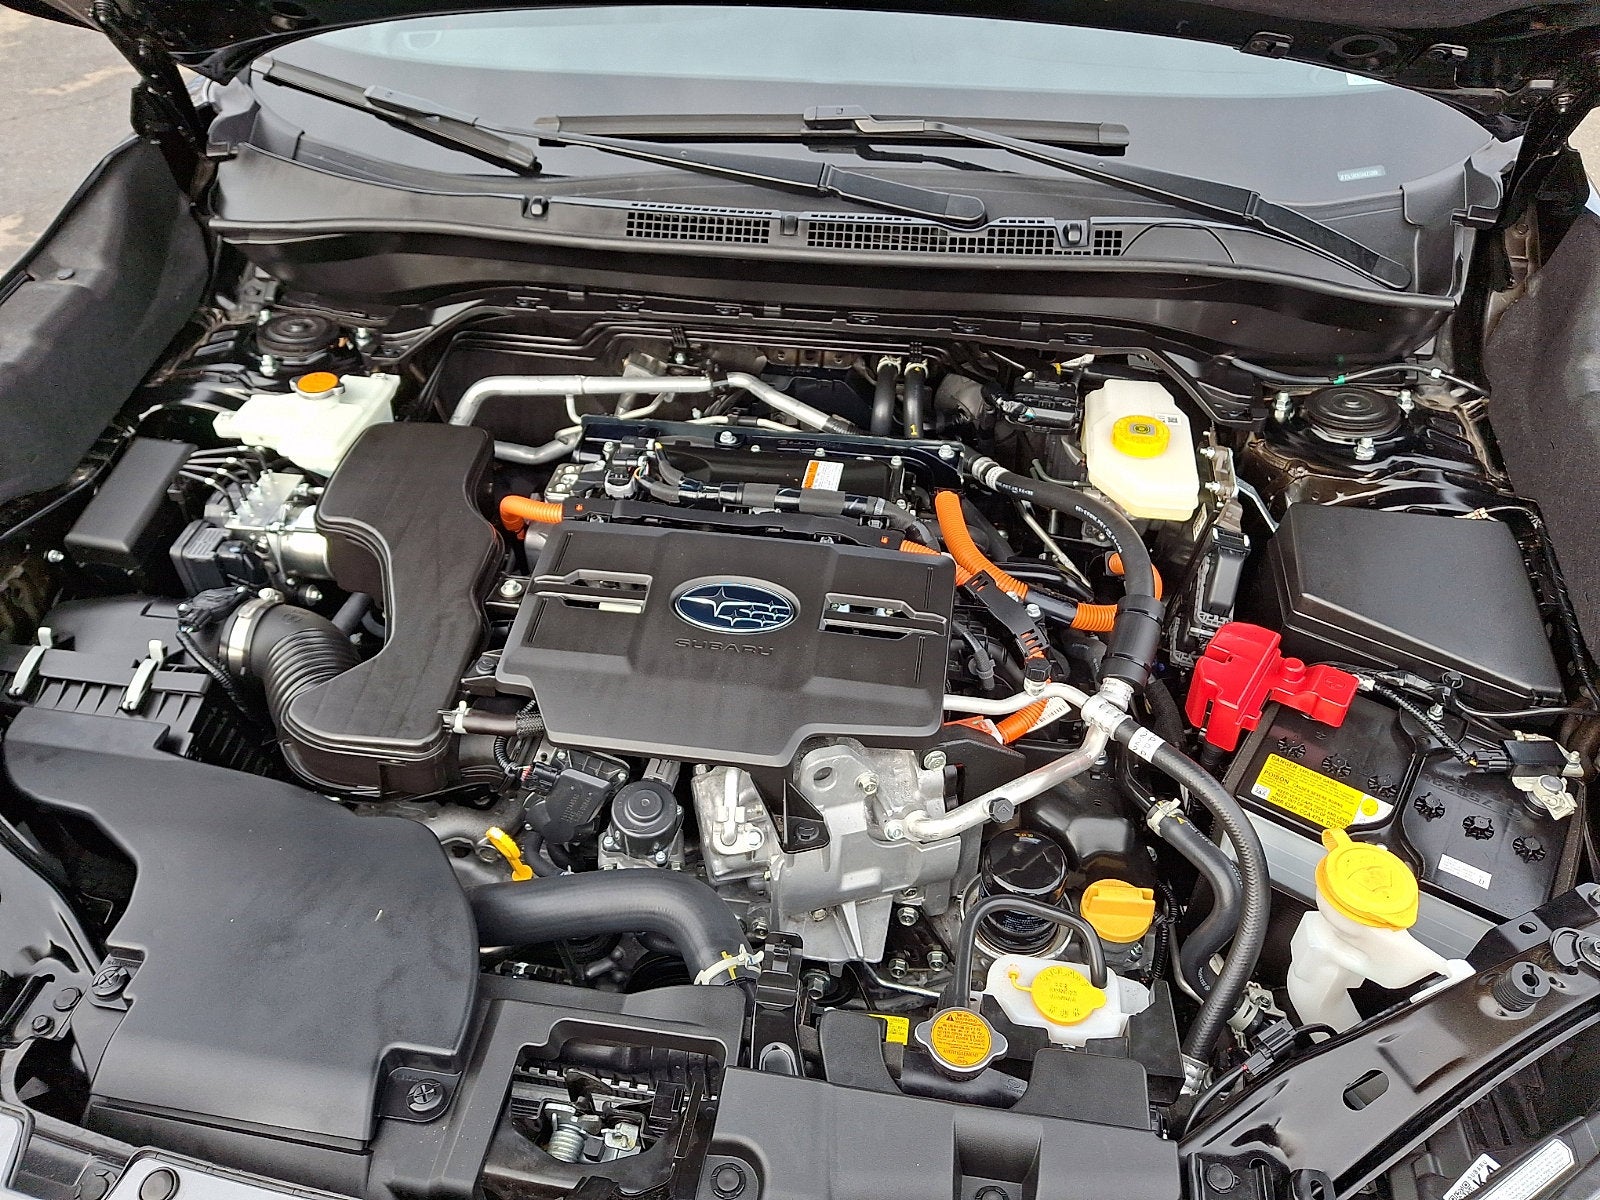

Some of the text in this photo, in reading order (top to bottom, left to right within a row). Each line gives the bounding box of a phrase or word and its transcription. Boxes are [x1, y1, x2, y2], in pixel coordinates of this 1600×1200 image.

[910, 424, 918, 436] 1
[674, 638, 774, 656] SUBARU
[1271, 755, 1297, 769] DANGER
[1263, 770, 1289, 784] POISON
[1467, 1160, 1488, 1181] SUBARU
